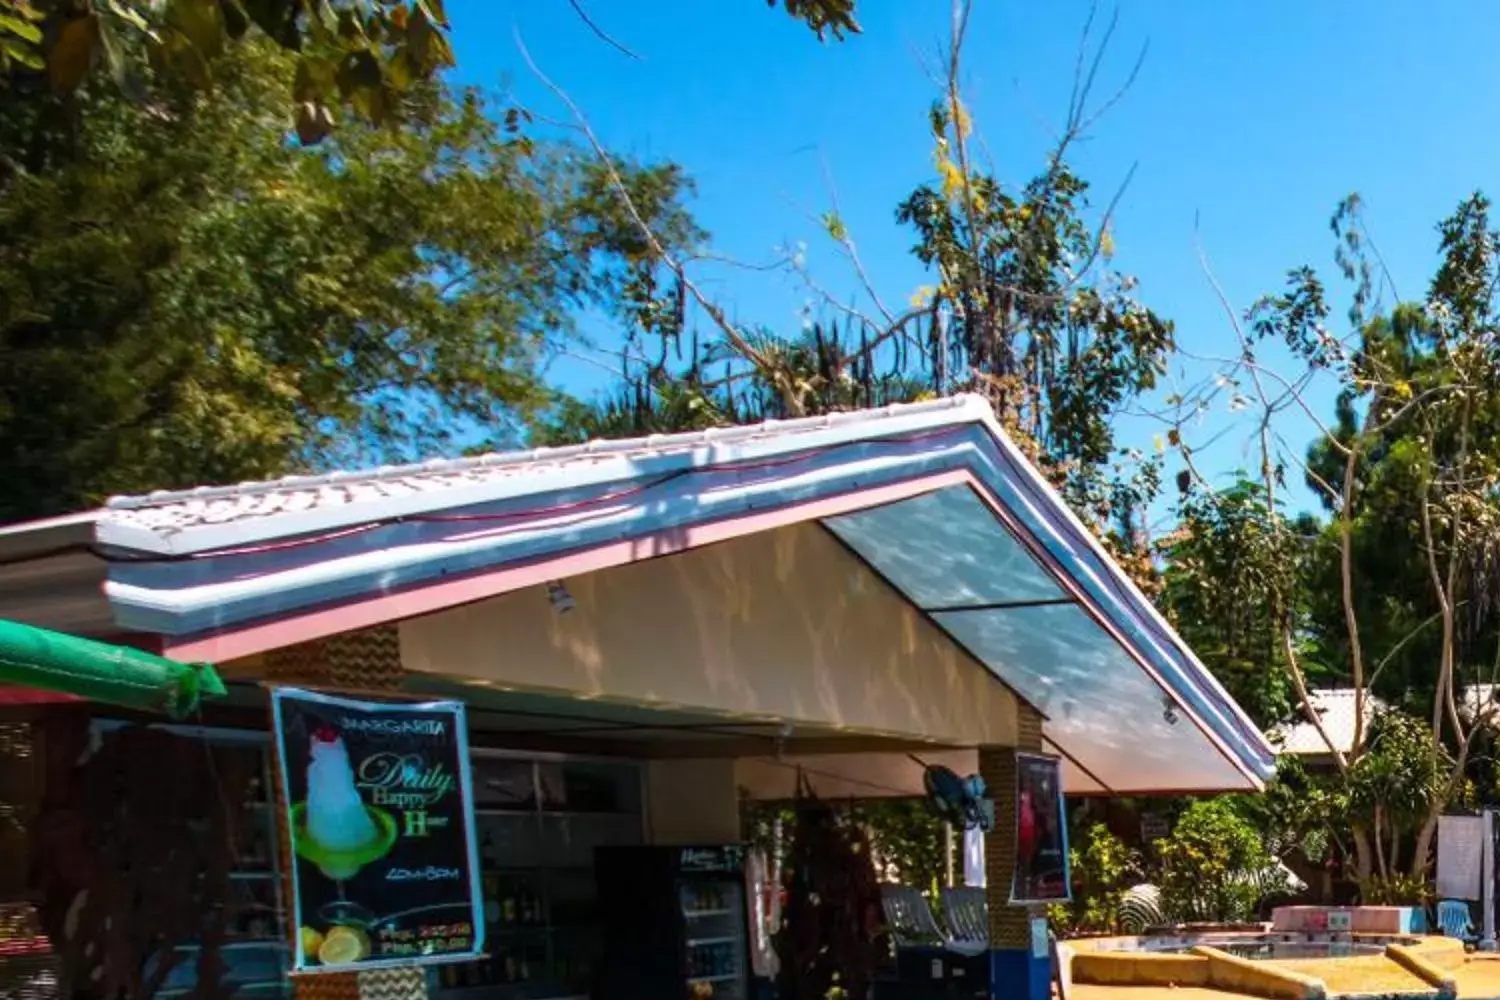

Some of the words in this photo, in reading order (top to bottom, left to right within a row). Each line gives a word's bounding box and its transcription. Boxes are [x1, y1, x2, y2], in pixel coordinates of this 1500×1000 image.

[342, 718, 444, 735] MARGARITA
[357, 752, 453, 801] Daily
[372, 788, 425, 808] Happy
